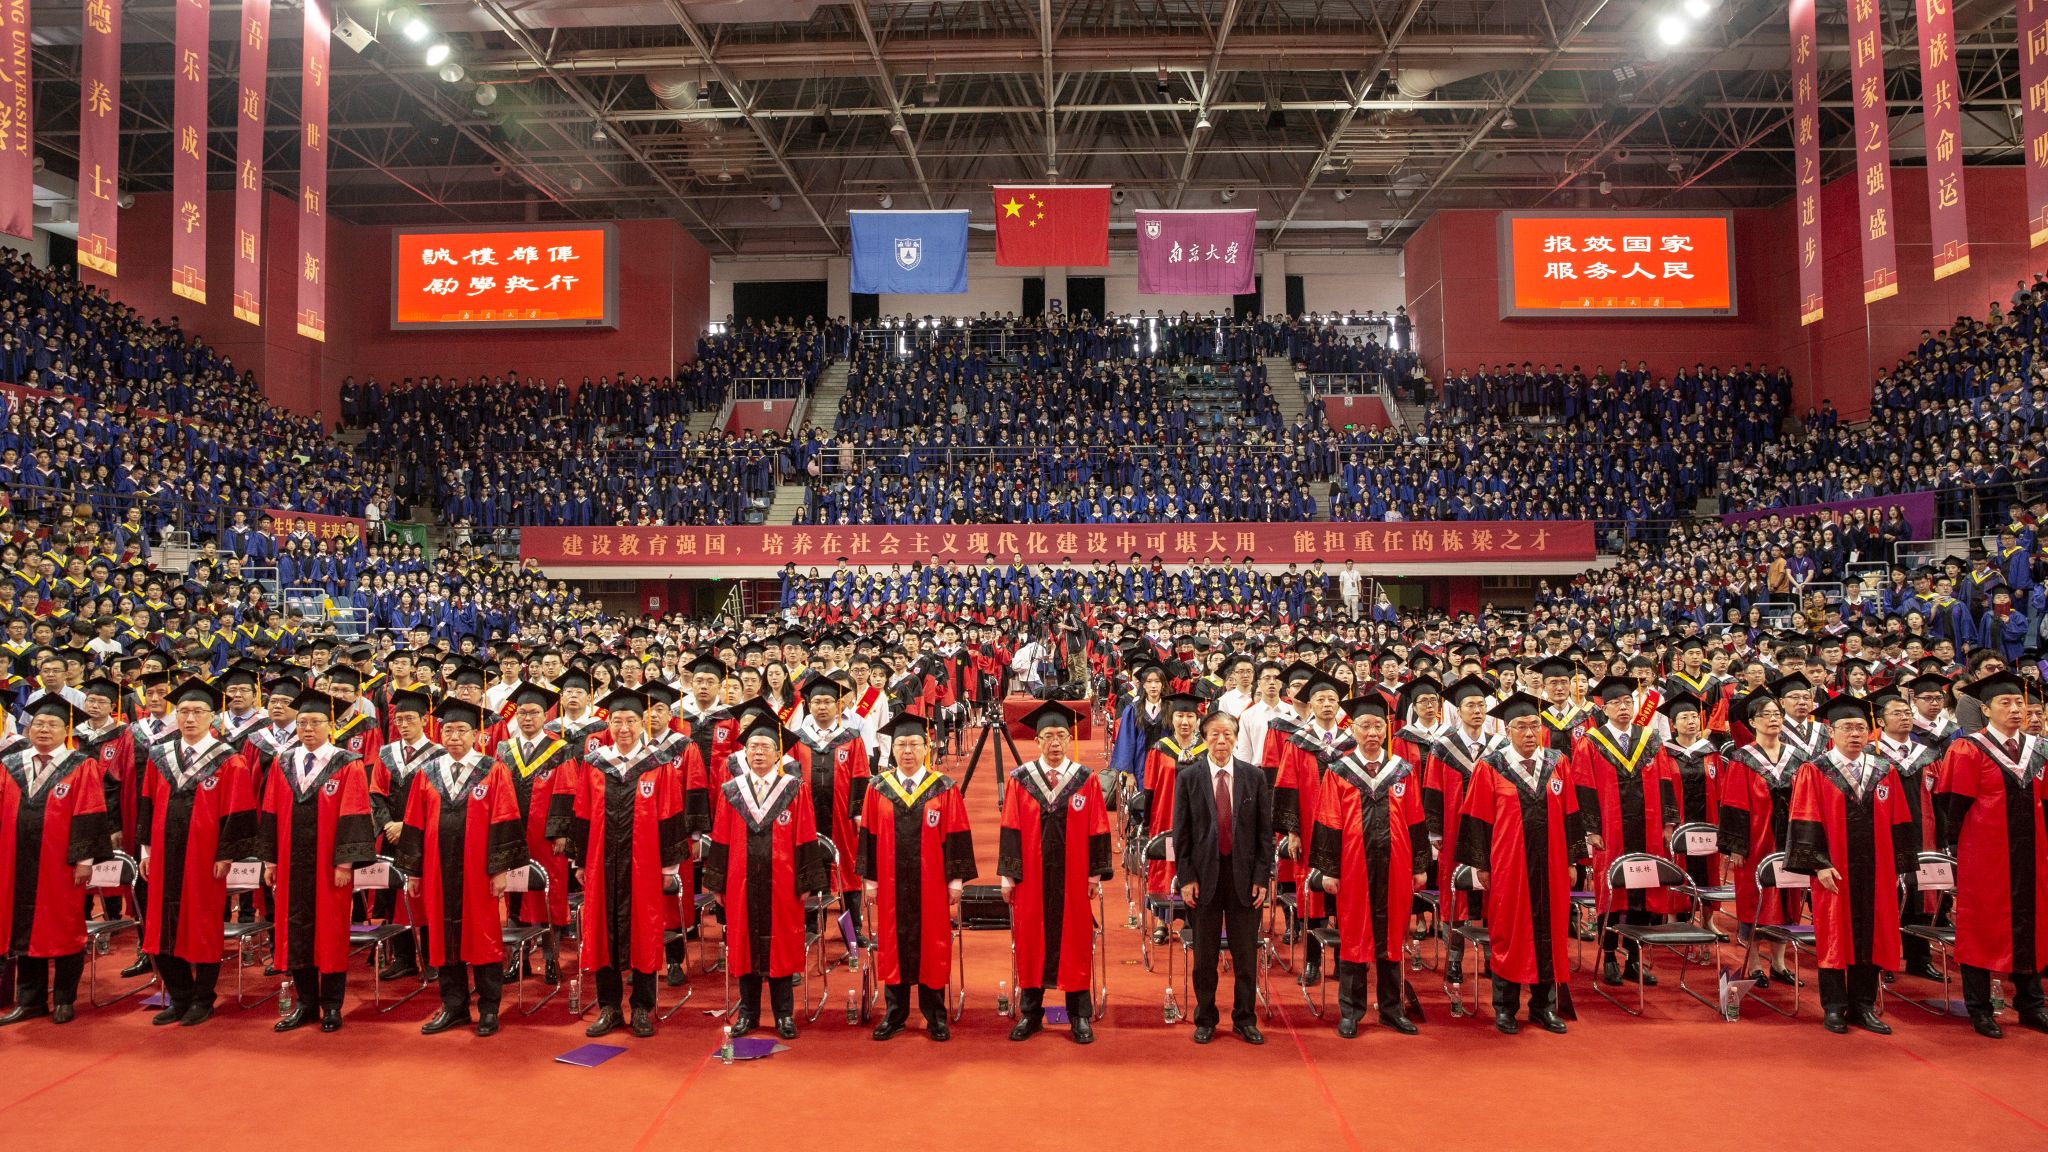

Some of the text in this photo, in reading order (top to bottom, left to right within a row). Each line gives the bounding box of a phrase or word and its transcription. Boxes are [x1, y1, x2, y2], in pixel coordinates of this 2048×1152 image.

[12, 30, 27, 158] UNIVERSITY
[181, 0, 202, 234] 乐成学
[241, 17, 264, 264] 吾道在国
[303, 55, 325, 285] 与世恒新
[1797, 34, 1816, 269] 求科教之进步
[1050, 299, 1062, 314] B
[1543, 235, 1694, 253] 报效国家
[1543, 261, 1695, 280] 服务人民
